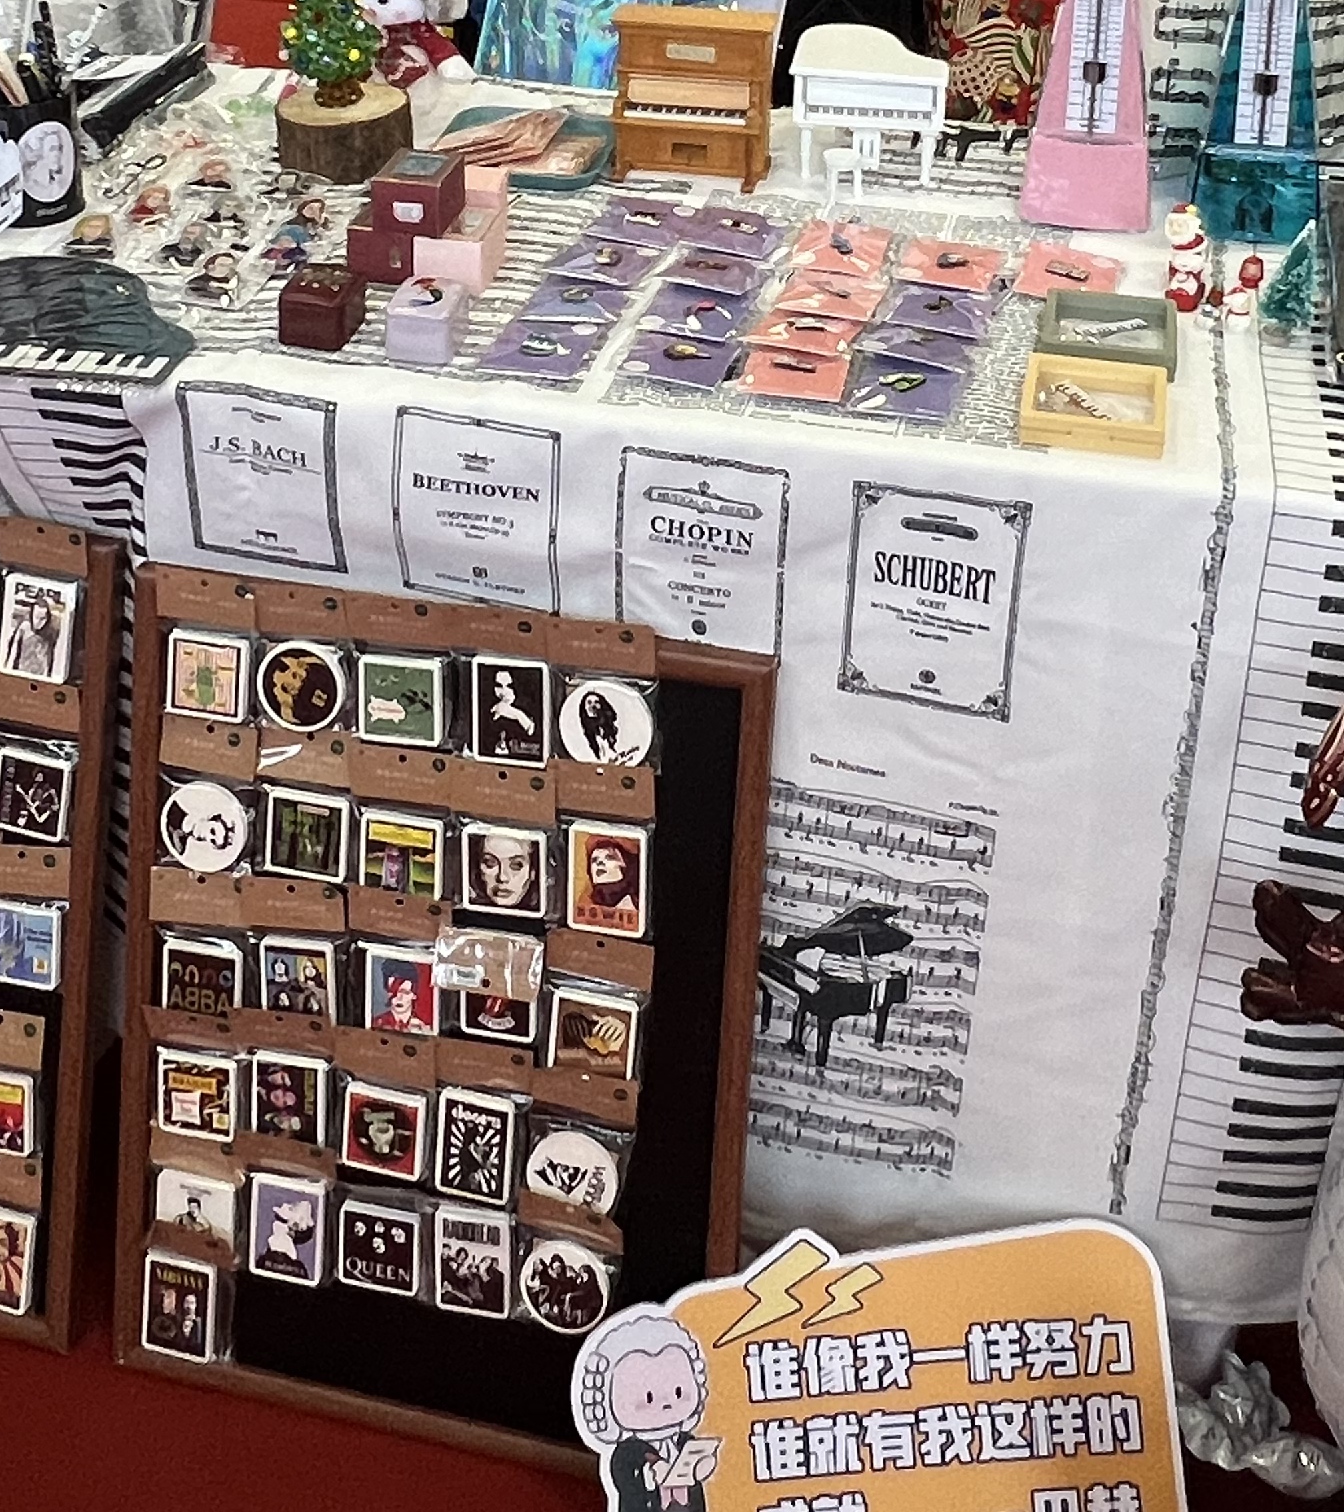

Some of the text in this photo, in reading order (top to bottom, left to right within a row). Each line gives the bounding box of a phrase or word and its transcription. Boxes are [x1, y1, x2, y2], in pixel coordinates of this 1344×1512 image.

[250, 436, 309, 469] BACH
[412, 471, 541, 503] BEETHOVEN
[650, 515, 754, 550] CHOPIN
[667, 580, 732, 598] CONCERTO
[873, 550, 997, 605] SCHUBERT
[345, 1256, 412, 1284] QUEEN
[743, 1314, 1136, 1402] 谁像我一样努力
[749, 1393, 1144, 1482] 谁就有我这样的
